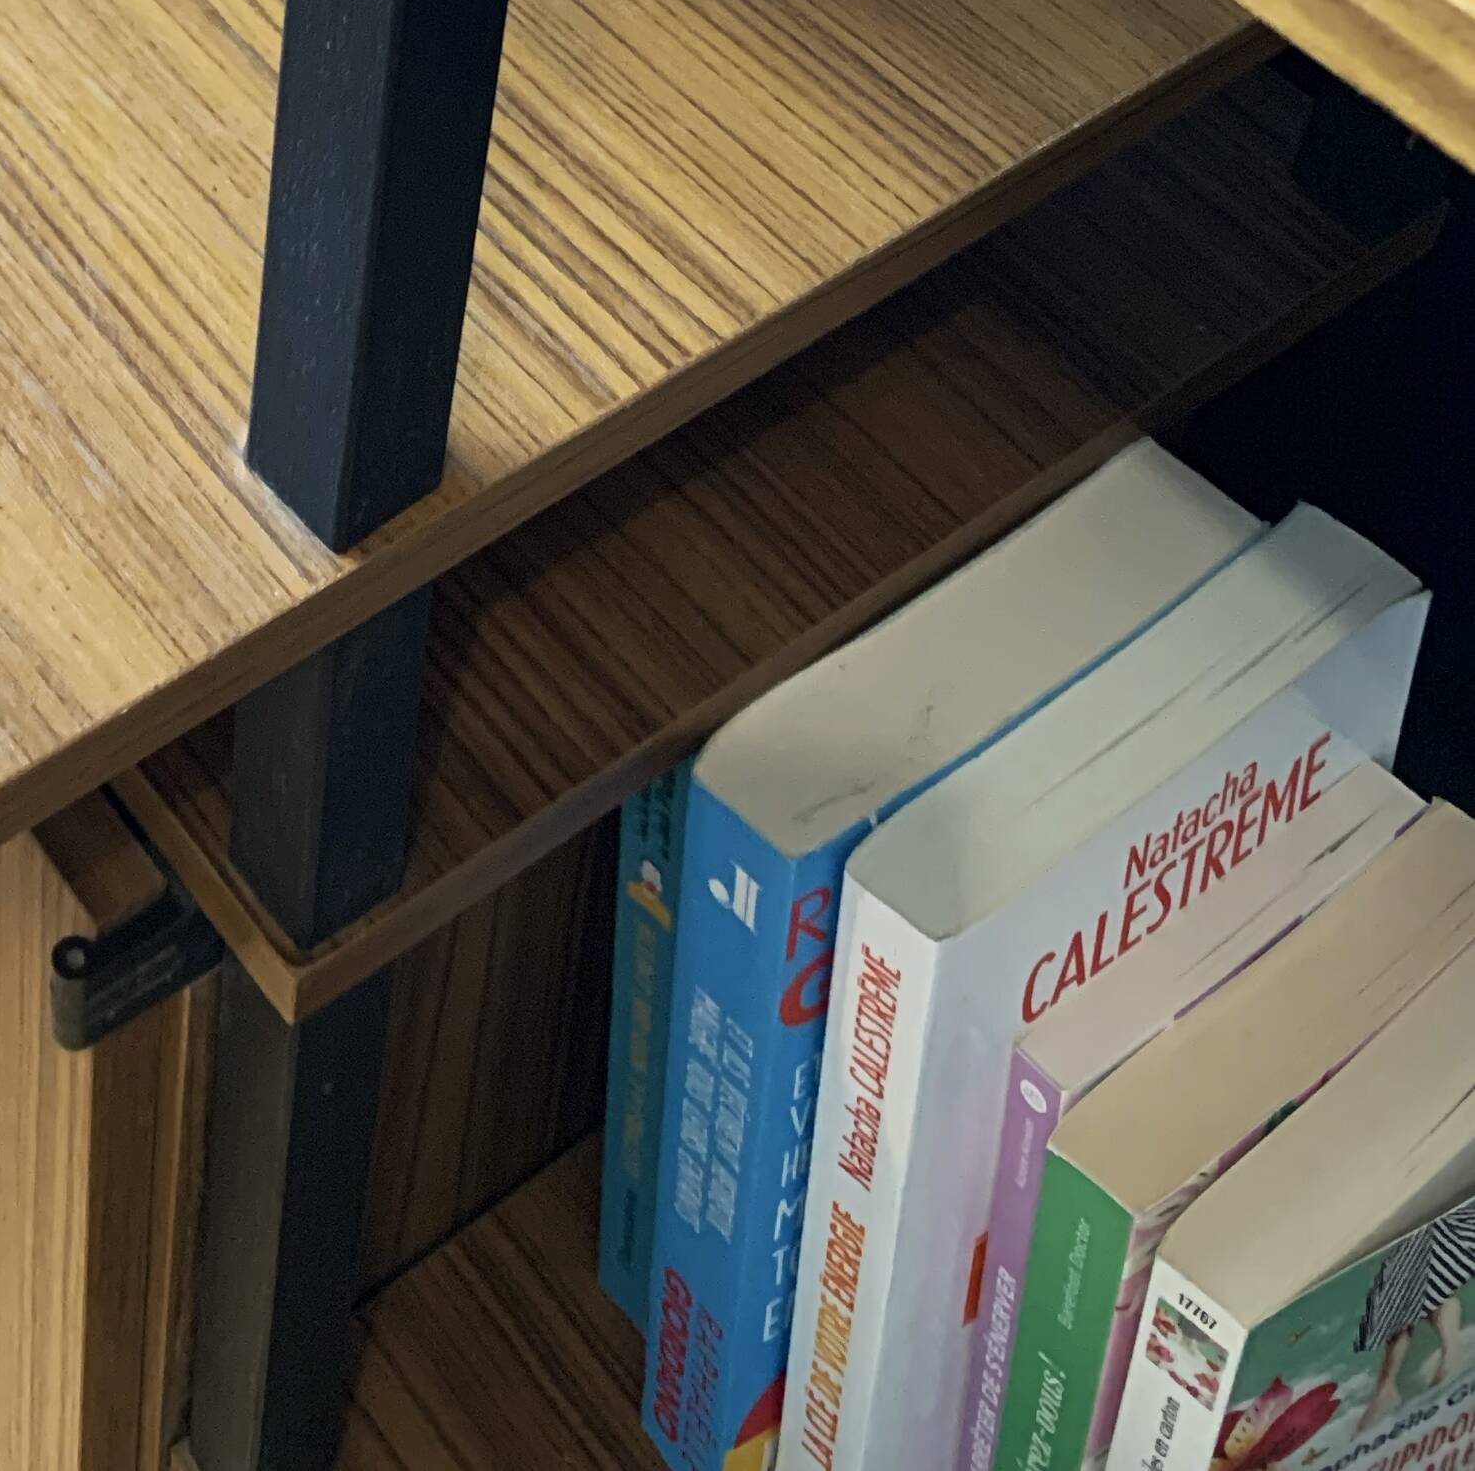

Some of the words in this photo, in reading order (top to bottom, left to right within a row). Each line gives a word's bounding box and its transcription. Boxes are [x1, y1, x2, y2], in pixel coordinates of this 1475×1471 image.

[1124, 760, 1258, 889] Natacha
[838, 1095, 881, 1192] Natacha
[1159, 1396, 1181, 1440] carton
